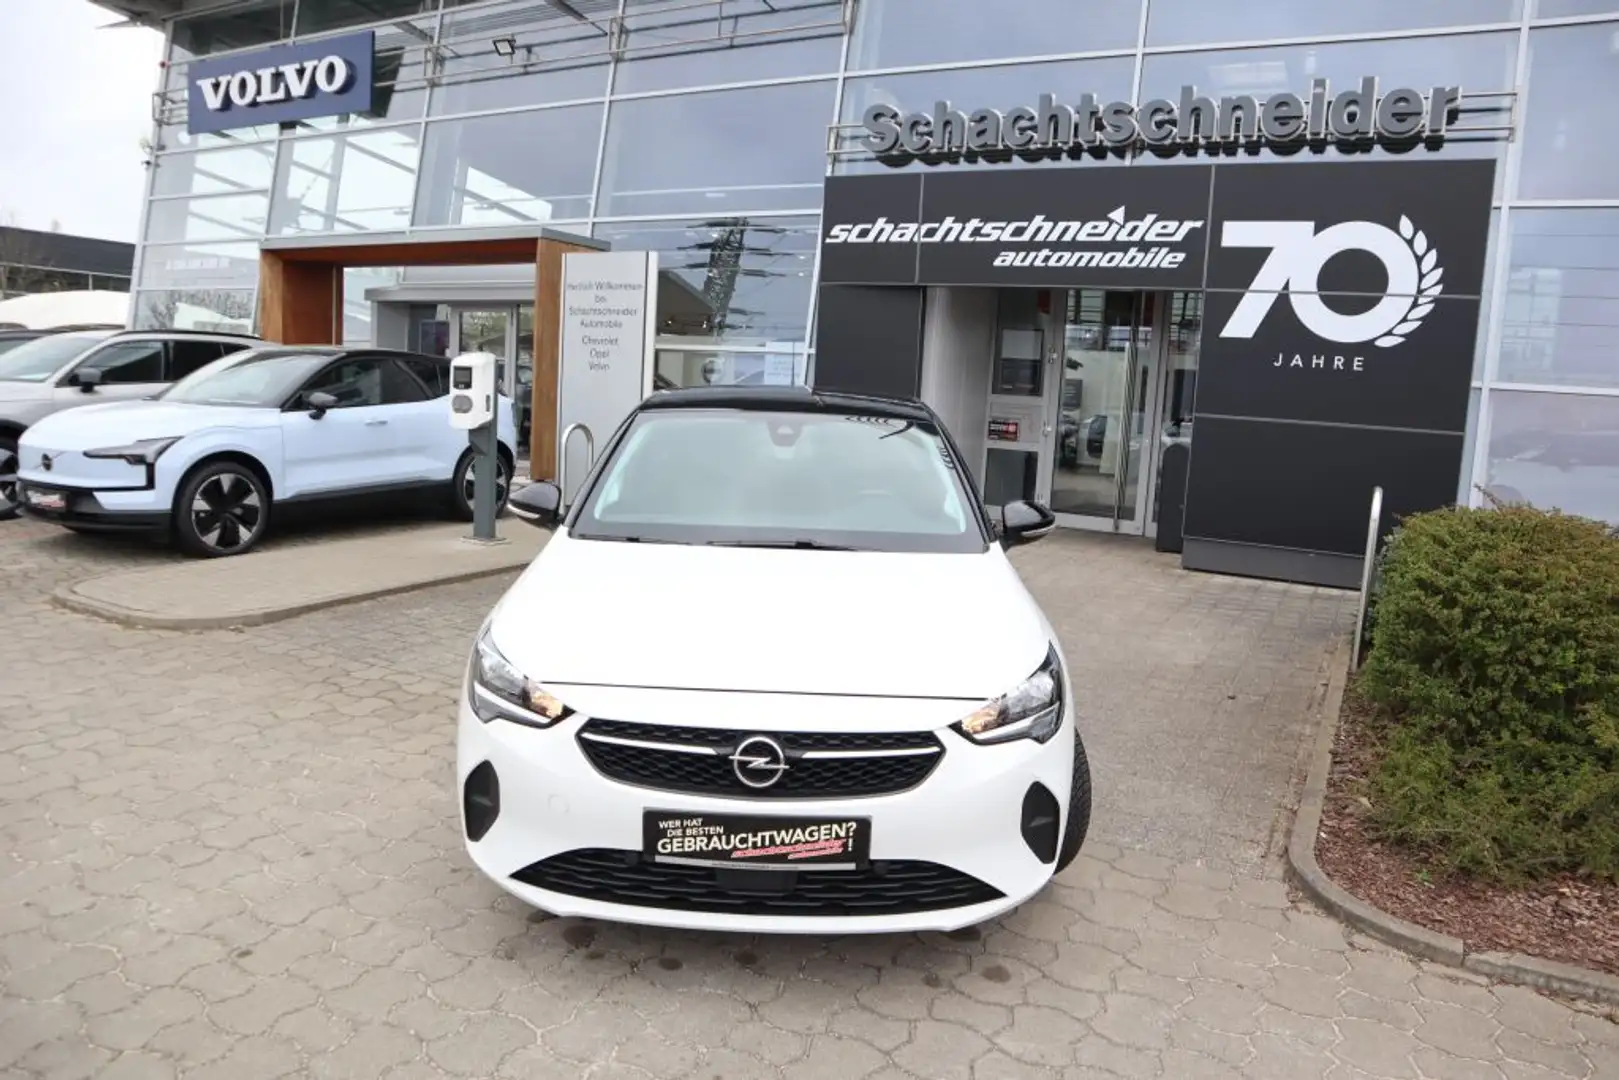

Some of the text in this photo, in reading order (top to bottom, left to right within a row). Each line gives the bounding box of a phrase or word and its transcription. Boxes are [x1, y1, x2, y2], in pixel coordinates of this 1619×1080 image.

[196, 55, 347, 110] VOLVO
[860, 75, 1460, 155] Schachtschneider
[825, 205, 1204, 244] schachtschneider
[993, 247, 1186, 269] automobile
[1219, 220, 1420, 343] 70
[1273, 353, 1364, 371] JAHRE
[658, 818, 703, 829] WER HAT
[667, 826, 724, 837] DIE BESTEN
